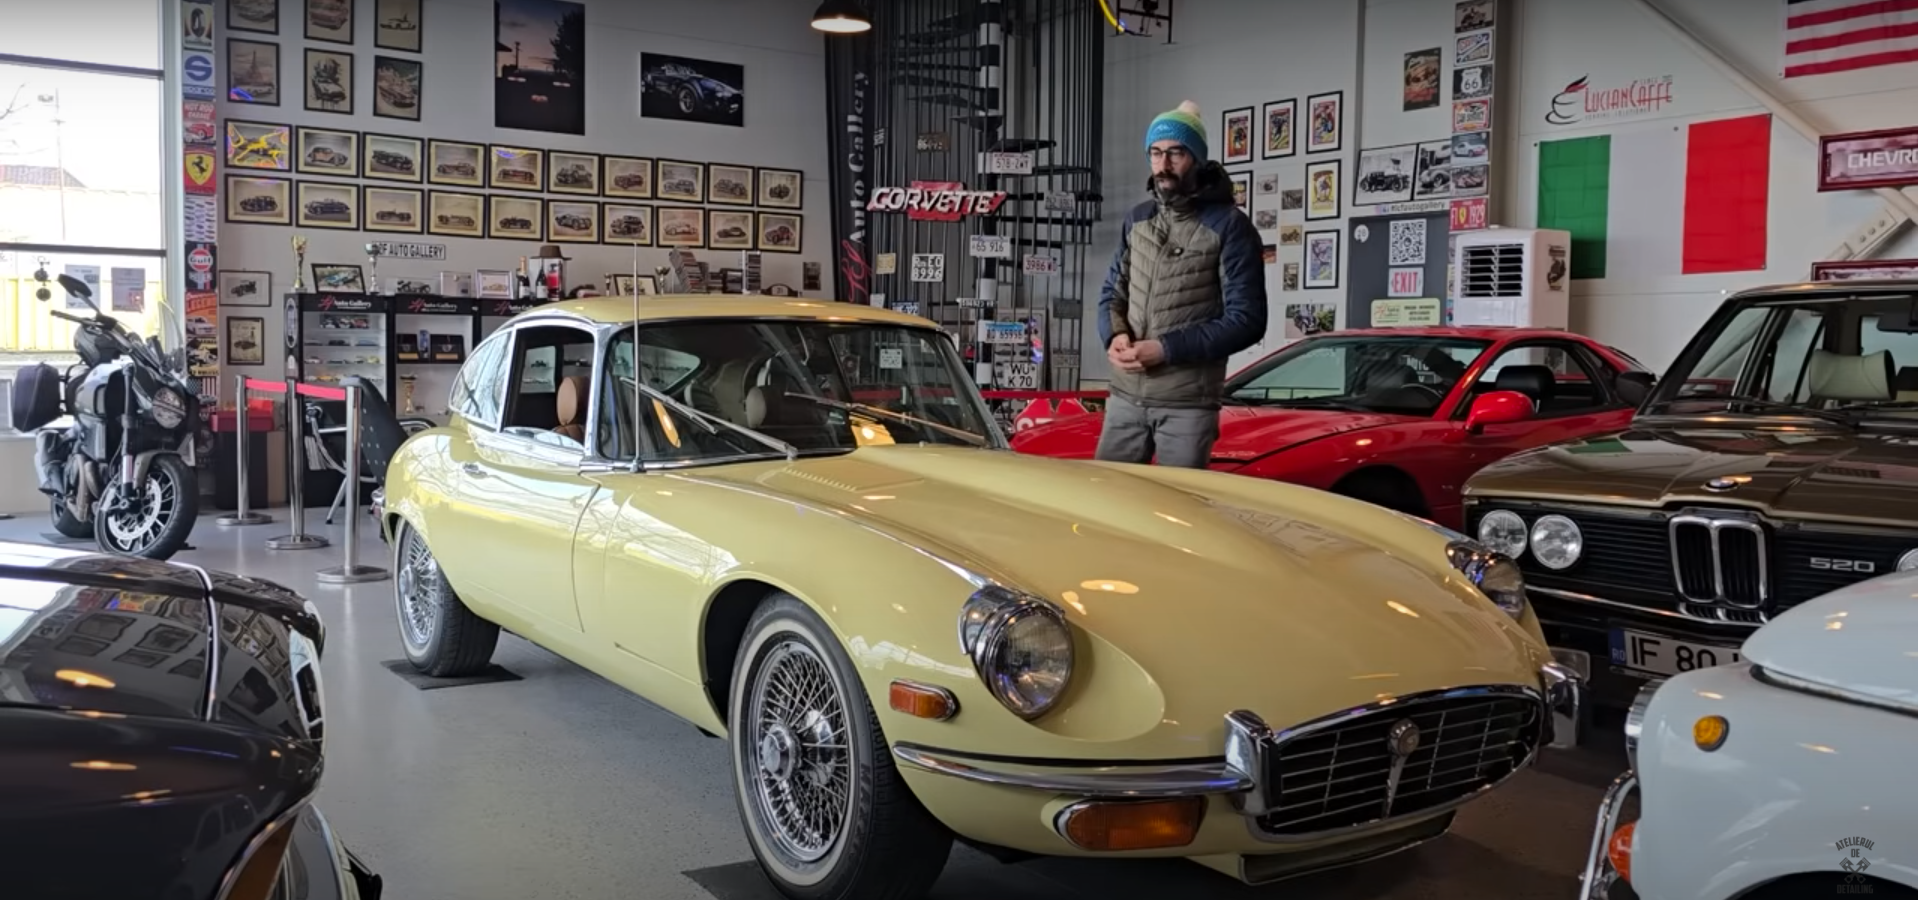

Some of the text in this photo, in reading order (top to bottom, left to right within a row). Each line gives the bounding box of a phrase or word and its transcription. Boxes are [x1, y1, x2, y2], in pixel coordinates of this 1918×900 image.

[1464, 79, 1478, 90] 66
[874, 188, 995, 213] CORVETTE
[410, 244, 443, 258] GALLERY
[1393, 272, 1418, 293] EXIT
[1019, 376, 1032, 387] 70
[1810, 557, 1875, 573] 520
